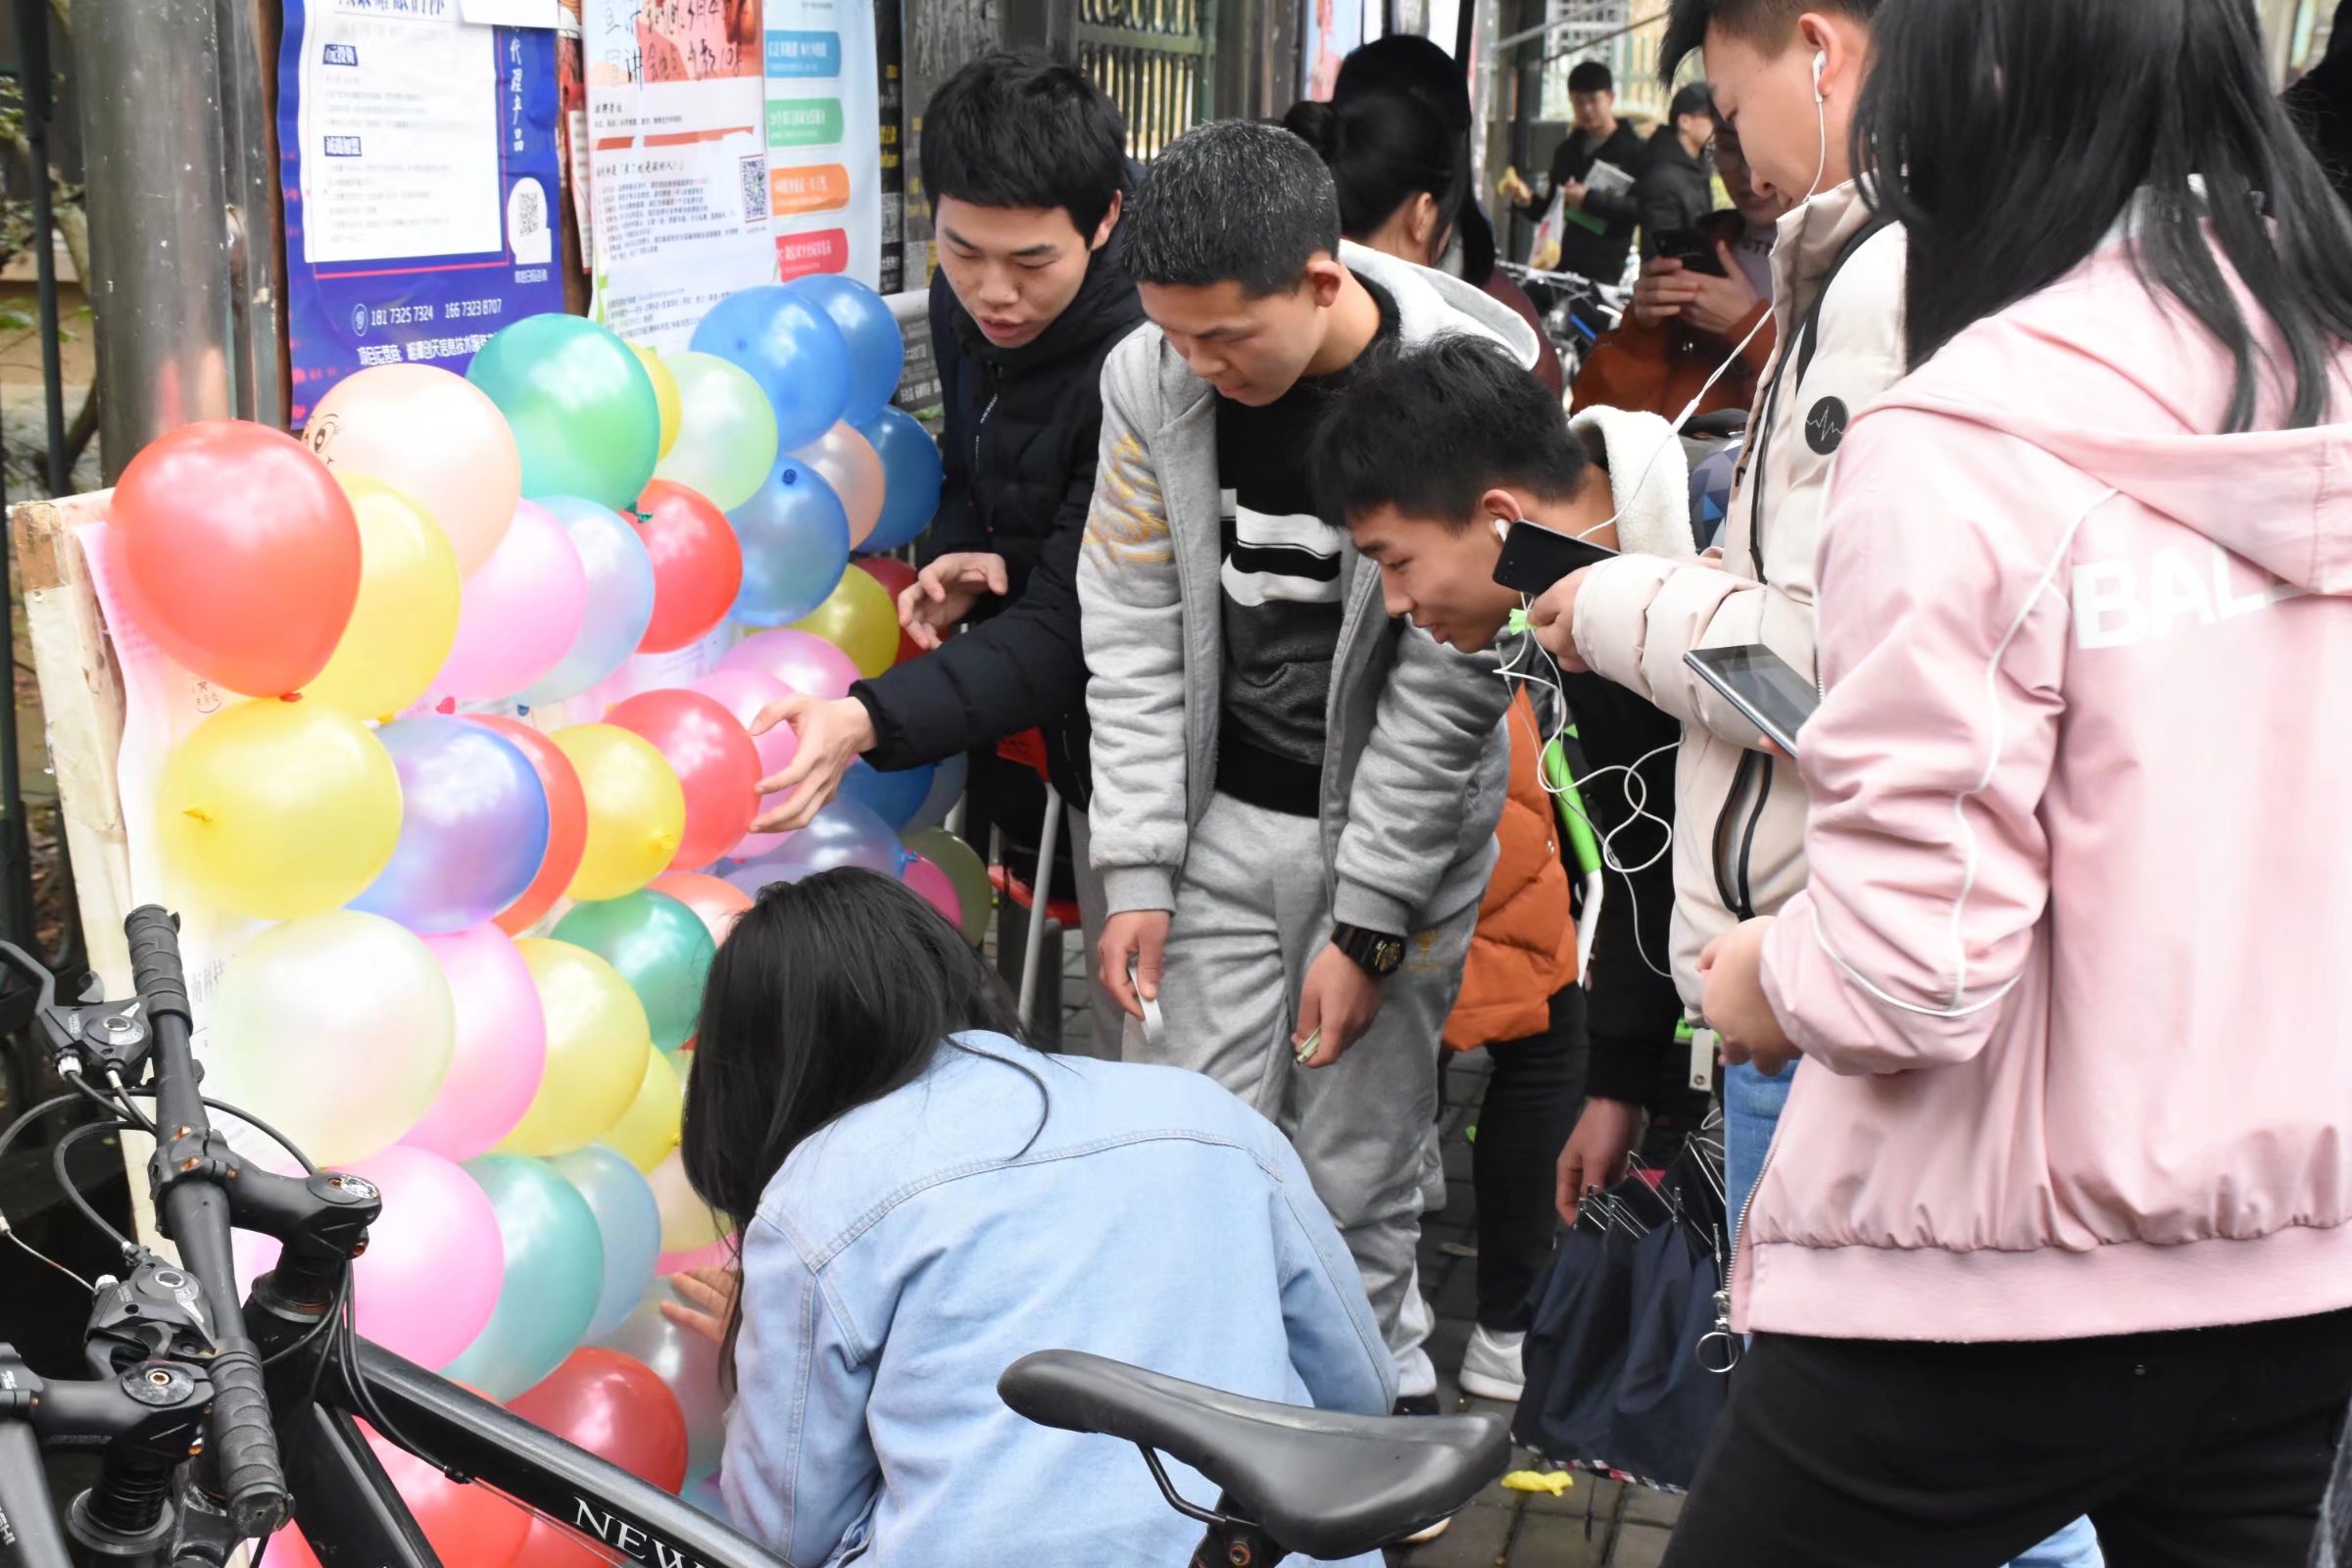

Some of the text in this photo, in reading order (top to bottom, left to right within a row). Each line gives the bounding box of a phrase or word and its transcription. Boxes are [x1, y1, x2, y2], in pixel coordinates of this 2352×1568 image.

[370, 310, 388, 326] 181
[390, 307, 413, 323] 7325
[414, 305, 434, 322] 7324
[2072, 542, 2305, 650] BAL
